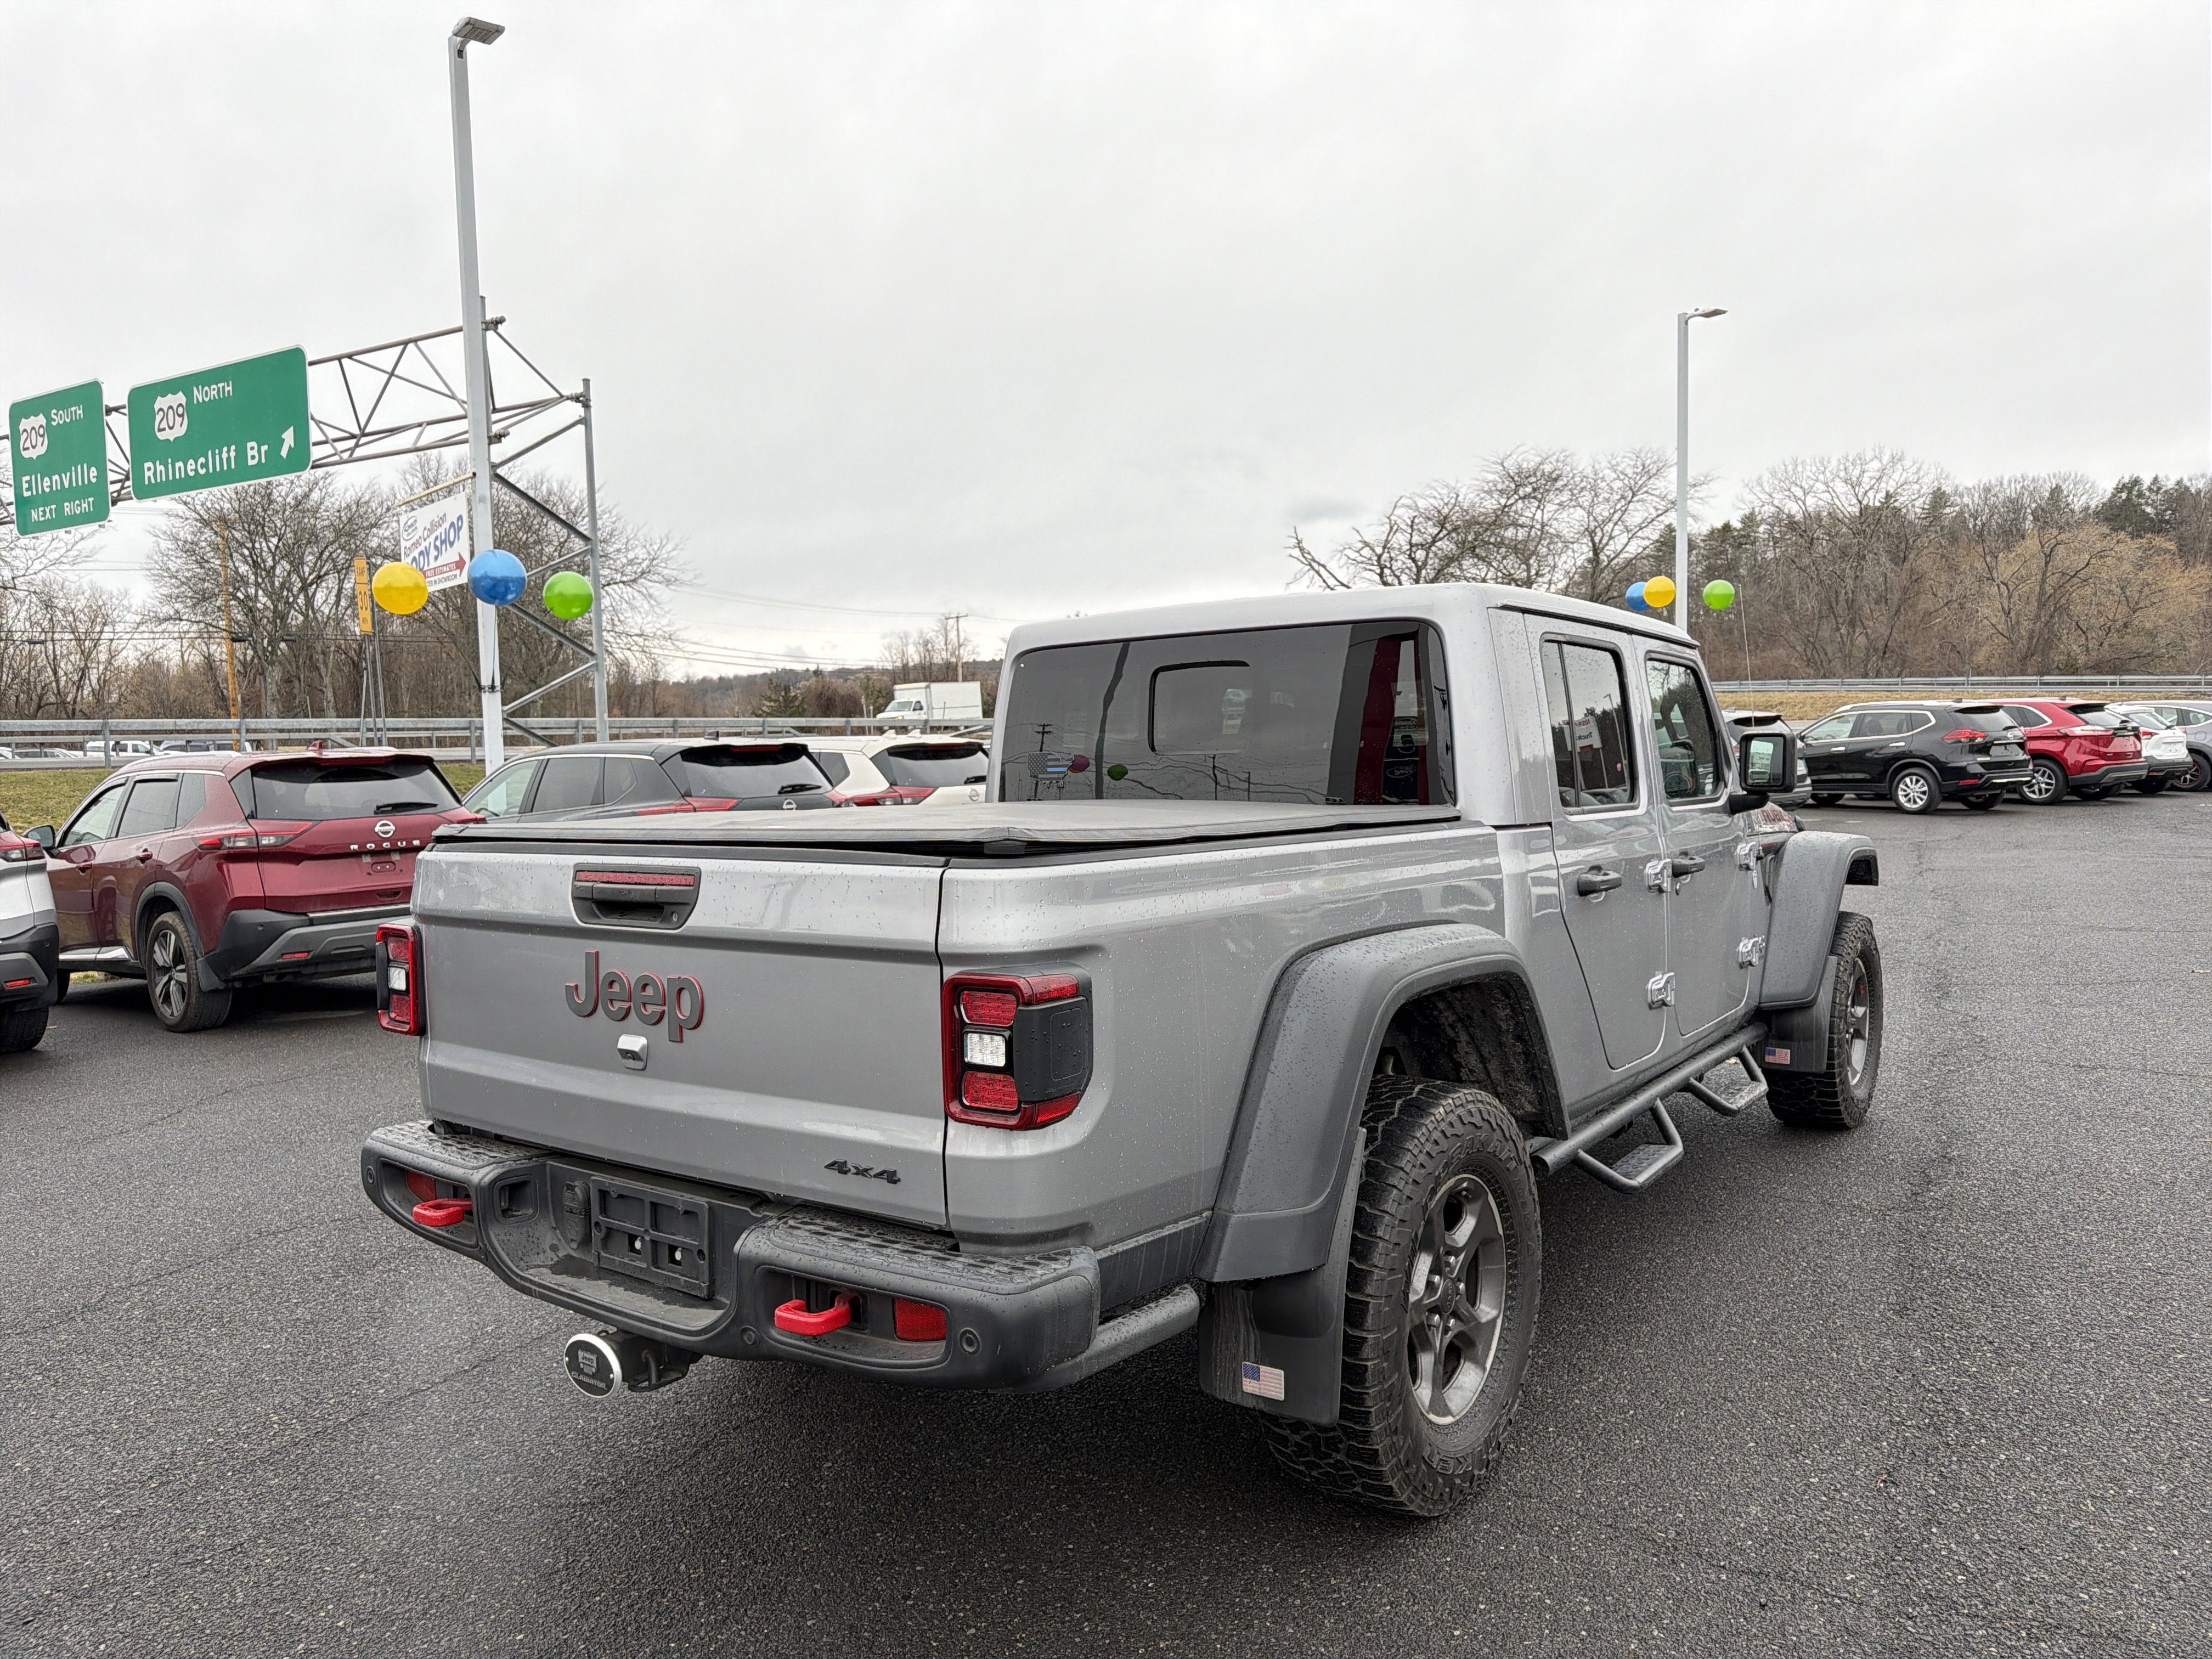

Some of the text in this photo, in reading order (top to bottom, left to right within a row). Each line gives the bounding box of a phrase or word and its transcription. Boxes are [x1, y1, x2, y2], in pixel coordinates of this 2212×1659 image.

[194, 381, 233, 404] NORTH
[51, 405, 83, 426] SOUTH
[157, 403, 185, 432] 209
[21, 424, 45, 452] 209
[144, 441, 268, 485] Rhinecliff Br
[22, 462, 98, 497] Ellenville
[31, 497, 94, 522] NEXT RIGHT
[404, 536, 422, 560] Romeo
[422, 512, 446, 542] Collision
[408, 541, 431, 572] ODY
[434, 514, 464, 562] SHOP
[425, 562, 456, 578] FREE ESTIMATES
[359, 590, 369, 611] 30
[350, 840, 420, 851] ROGUE
[565, 950, 704, 1043] Jeep
[582, 1353, 594, 1364] Jeep
[571, 1370, 607, 1390] GLADIATOR
